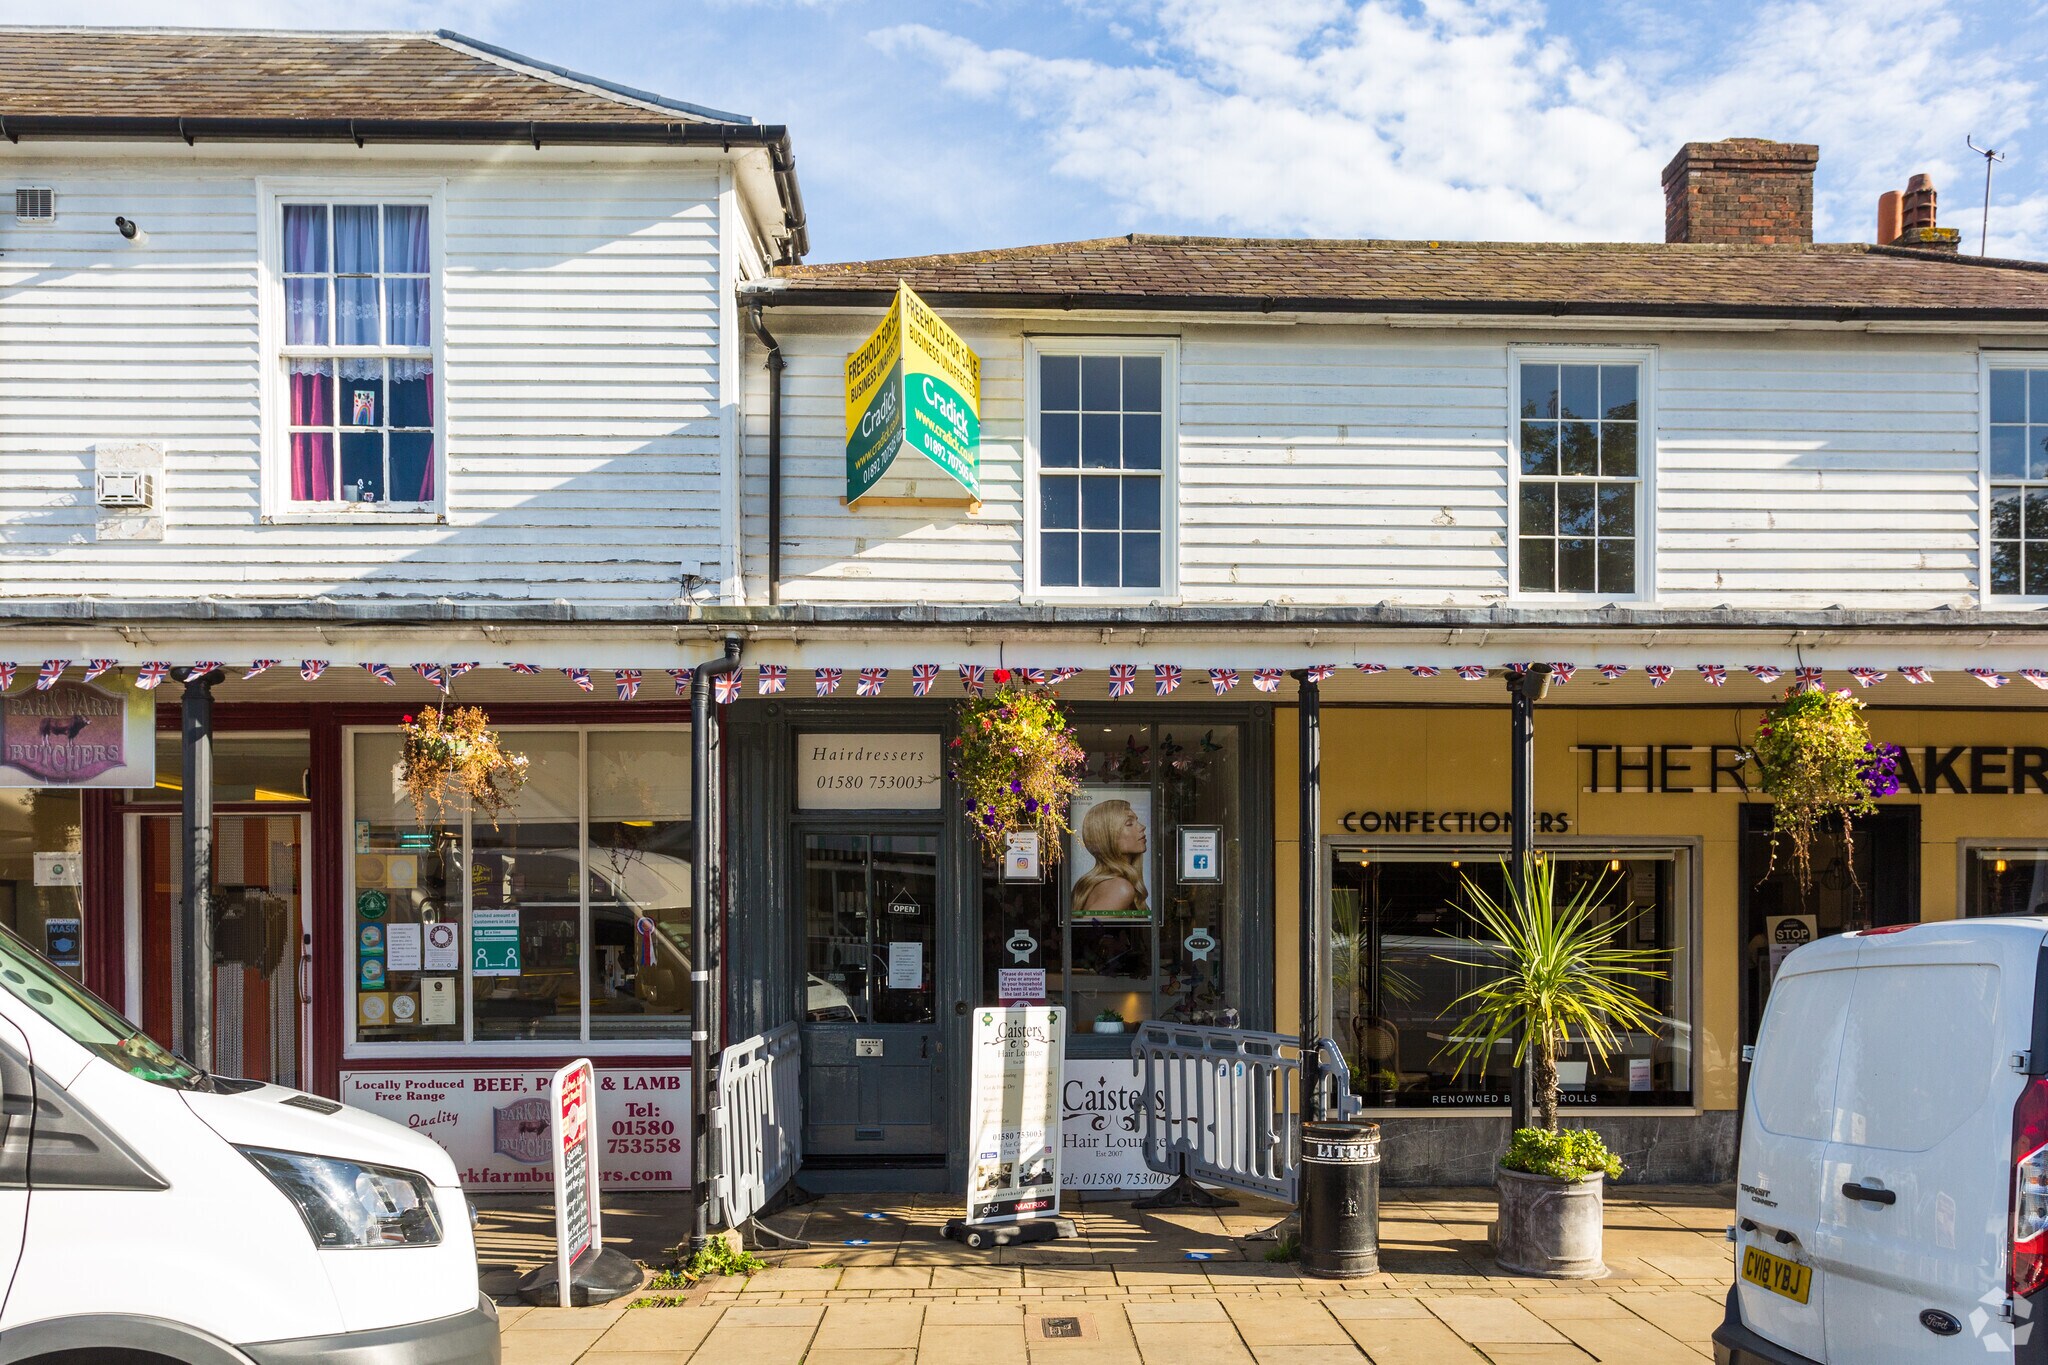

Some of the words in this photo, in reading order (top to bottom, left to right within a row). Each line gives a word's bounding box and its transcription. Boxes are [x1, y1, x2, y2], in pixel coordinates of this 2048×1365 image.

[906, 293, 945, 346] FREEHOLD
[946, 332, 960, 363] FOR
[962, 347, 978, 380] SALE
[848, 334, 881, 384] FREEHOLD
[881, 316, 892, 349] FOR
[909, 323, 940, 364] BUSINESS
[941, 352, 977, 398] UNAFFECTED
[850, 366, 877, 403] BUSINESS
[862, 381, 897, 438] Cradick
[922, 377, 969, 437] Cradick
[924, 433, 946, 462] 01892
[863, 458, 881, 483] 01892
[10, 688, 62, 716] PARK
[67, 687, 119, 716] FARM
[10, 743, 119, 772] BUTCHERS
[812, 746, 924, 761] Hairdressers
[1577, 744, 1694, 793] THE
[816, 775, 864, 789] 01580
[869, 775, 923, 789] 753003
[1343, 811, 1569, 833] CONFECTIONRS
[893, 905, 915, 913] OPEN
[49, 925, 78, 935] MASK
[1776, 929, 1809, 939] STOP
[998, 1020, 1042, 1039] Caisters
[998, 1049, 1015, 1058] Hair
[1016, 1049, 1044, 1059] Lounge
[355, 1079, 402, 1091] Locally
[405, 1079, 465, 1089] Produced
[473, 1077, 528, 1093] BEEF,
[600, 1076, 617, 1091] &
[623, 1076, 681, 1091] LAMB
[375, 1092, 402, 1101] Free
[406, 1091, 446, 1102] Range
[1063, 1077, 1165, 1111] Caistes
[1432, 1094, 1499, 1103] RENOWNED
[1560, 1094, 1597, 1103] ROLLS
[500, 1102, 532, 1120] PARK
[625, 1102, 660, 1118] Tel:
[408, 1110, 459, 1129] Quality
[611, 1120, 675, 1135] 01580
[992, 1132, 1014, 1140] 01580
[1016, 1130, 1042, 1139] 753003
[1063, 1133, 1100, 1148] Hair
[607, 1138, 681, 1153] 753558
[1317, 1144, 1376, 1158] LITTER
[1082, 1173, 1122, 1185] 01580
[1126, 1173, 1171, 1185] 753003
[1740, 1183, 1771, 1198] TRANSIT
[982, 1203, 999, 1217] ghd
[1014, 1200, 1047, 1210] MATRIX
[1751, 1196, 1778, 1208] CONNECT
[1746, 1251, 1771, 1283] CV18
[1774, 1261, 1802, 1295] YBJ
[1925, 1313, 1949, 1330] Ford
